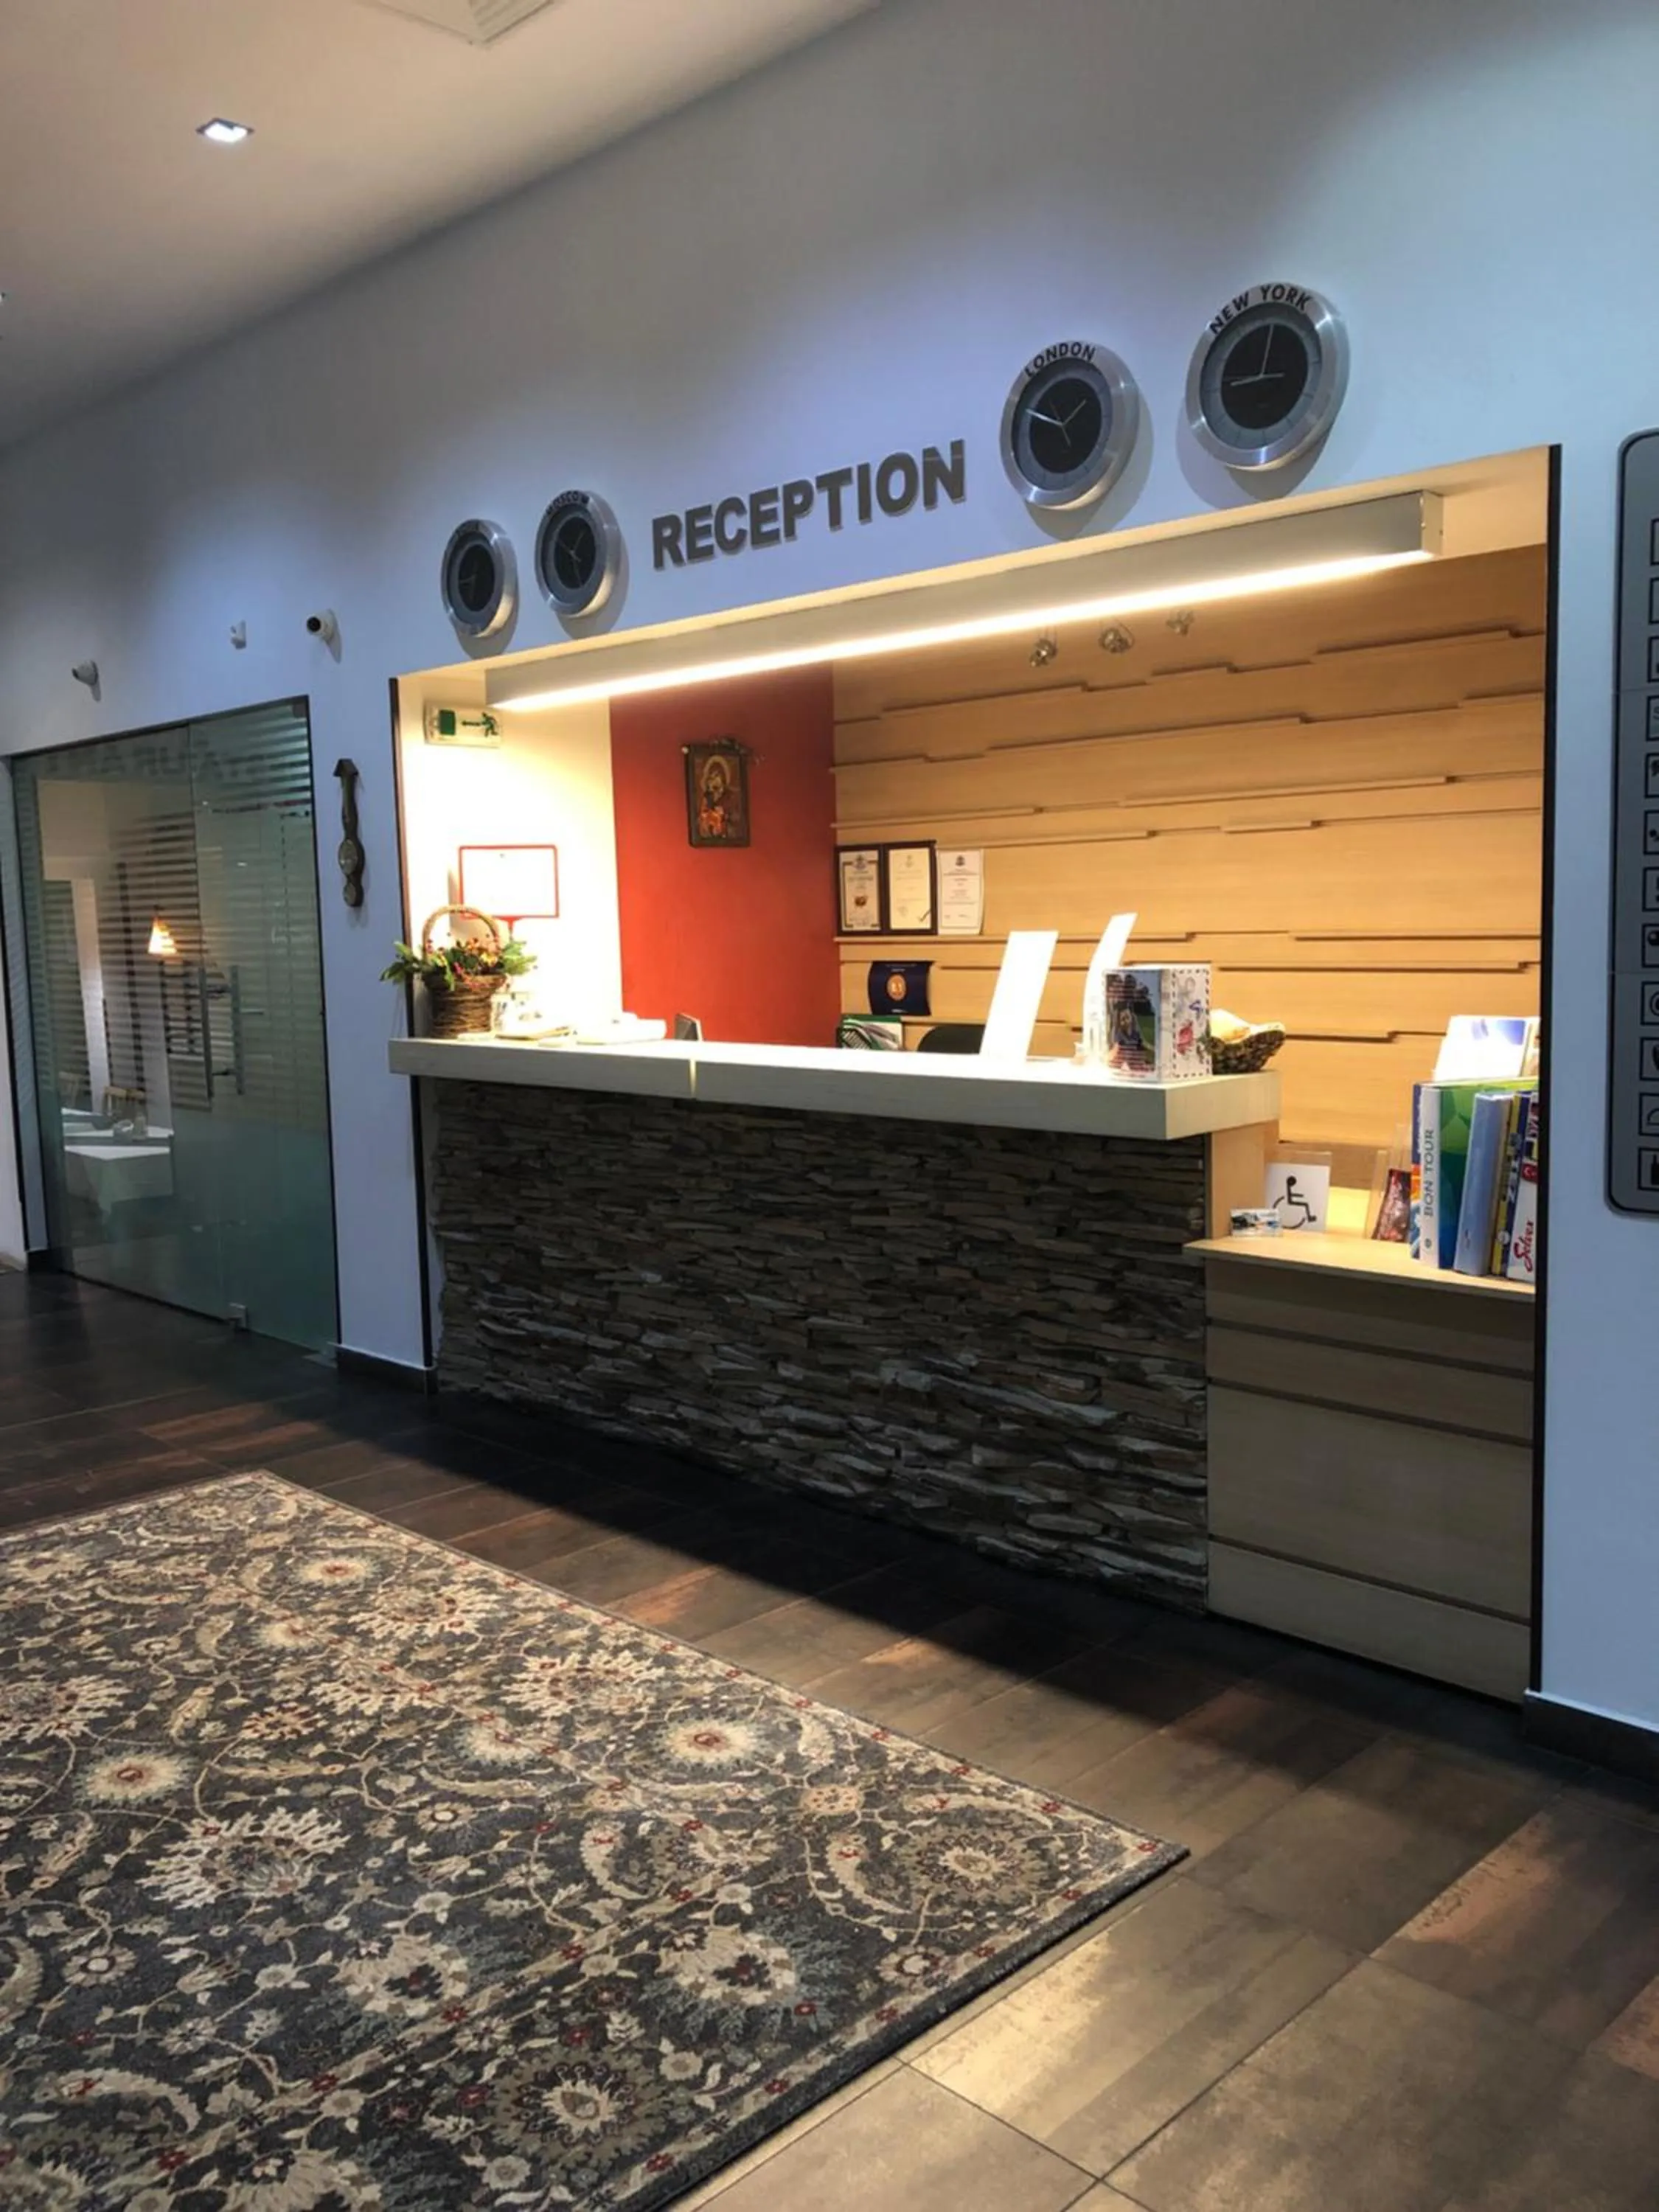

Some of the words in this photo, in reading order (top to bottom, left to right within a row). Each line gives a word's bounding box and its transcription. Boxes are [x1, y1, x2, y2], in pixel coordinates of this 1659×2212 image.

[1209, 291, 1249, 335] NEW
[1259, 284, 1312, 310] YORK
[1023, 341, 1096, 378] LONDON
[652, 439, 965, 570] RECEPTION
[1424, 1129, 1435, 1175] TOUR
[1424, 1180, 1435, 1217] BON
